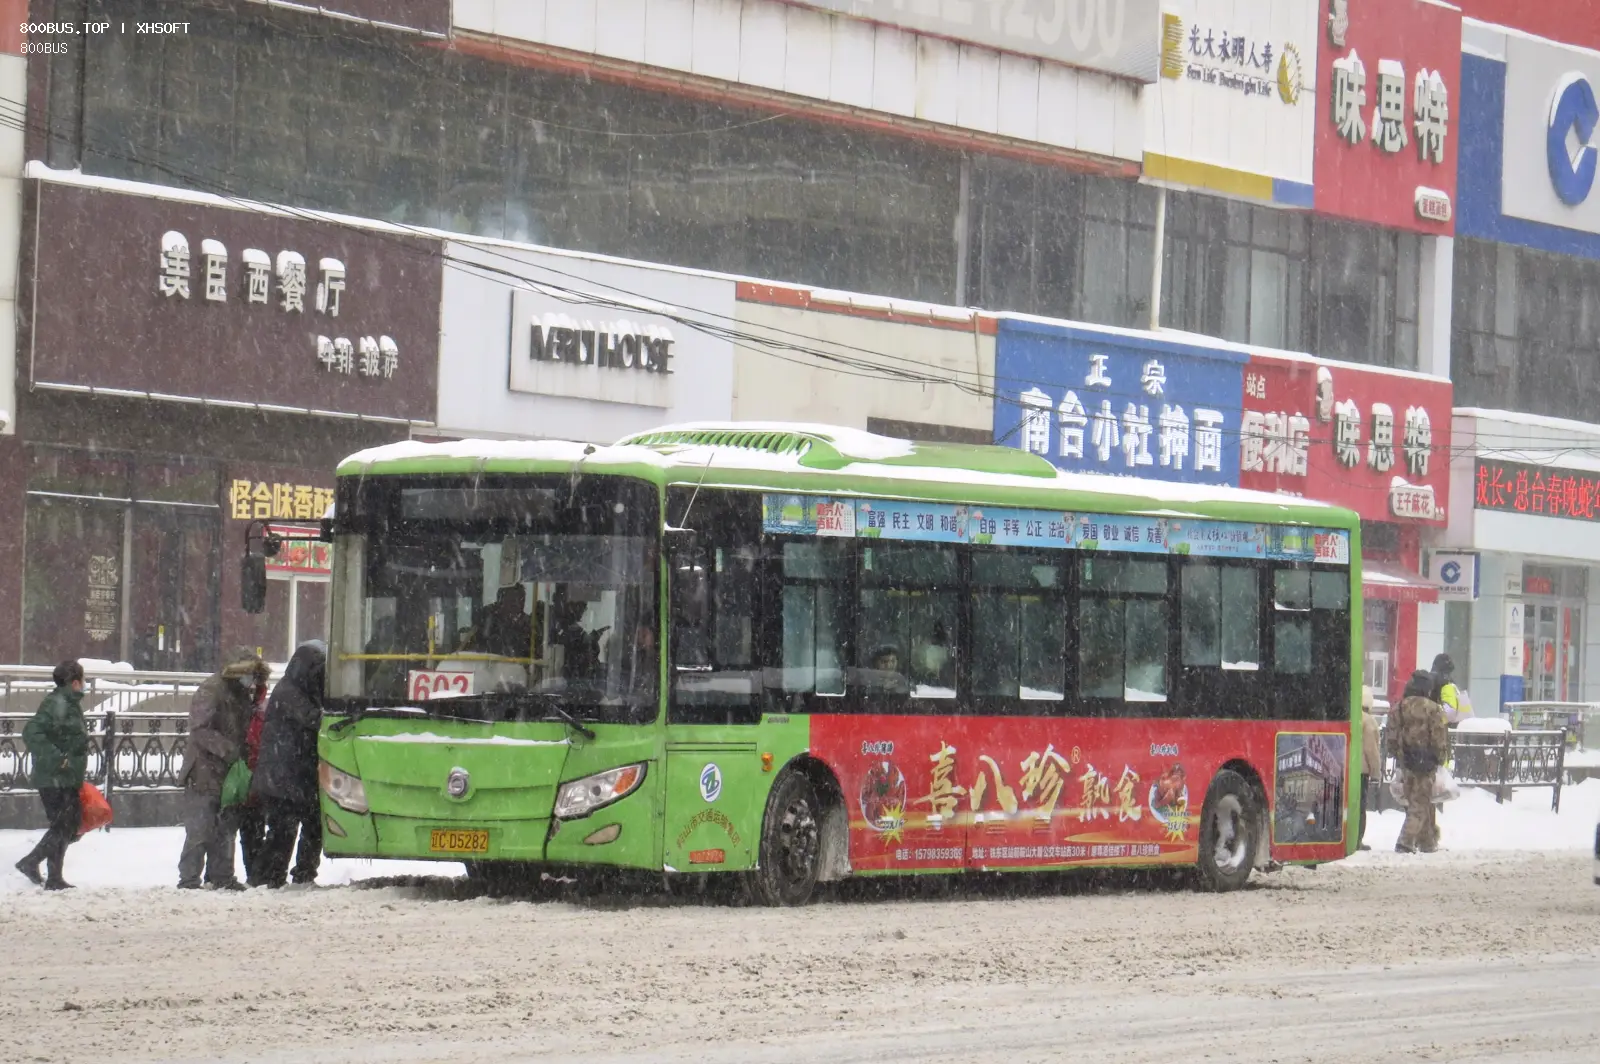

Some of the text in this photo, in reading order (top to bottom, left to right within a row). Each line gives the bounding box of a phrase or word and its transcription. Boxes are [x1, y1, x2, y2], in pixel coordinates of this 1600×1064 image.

[1188, 24, 1273, 74] 光大永明人寿
[1331, 56, 1450, 163] 味思特
[160, 234, 346, 317] 美臣西餐厅
[598, 332, 675, 374] HOUSE
[1085, 354, 1167, 395] 正宗
[1246, 374, 1266, 399] 站点
[1332, 402, 1432, 475] 味思特
[868, 511, 886, 528] 富强
[893, 514, 910, 530] 民主
[917, 515, 934, 531] 文明
[941, 516, 957, 533] 和谐
[980, 518, 997, 534] 自由
[1003, 519, 1020, 536] 平等
[1026, 520, 1043, 537] 公正
[1049, 522, 1065, 539] 法治
[1082, 523, 1098, 540] 爱国
[1103, 524, 1119, 541] 敬业
[1124, 525, 1140, 542] 诚信
[1147, 526, 1162, 543] 友善
[1079, 763, 1142, 822] 熟食
